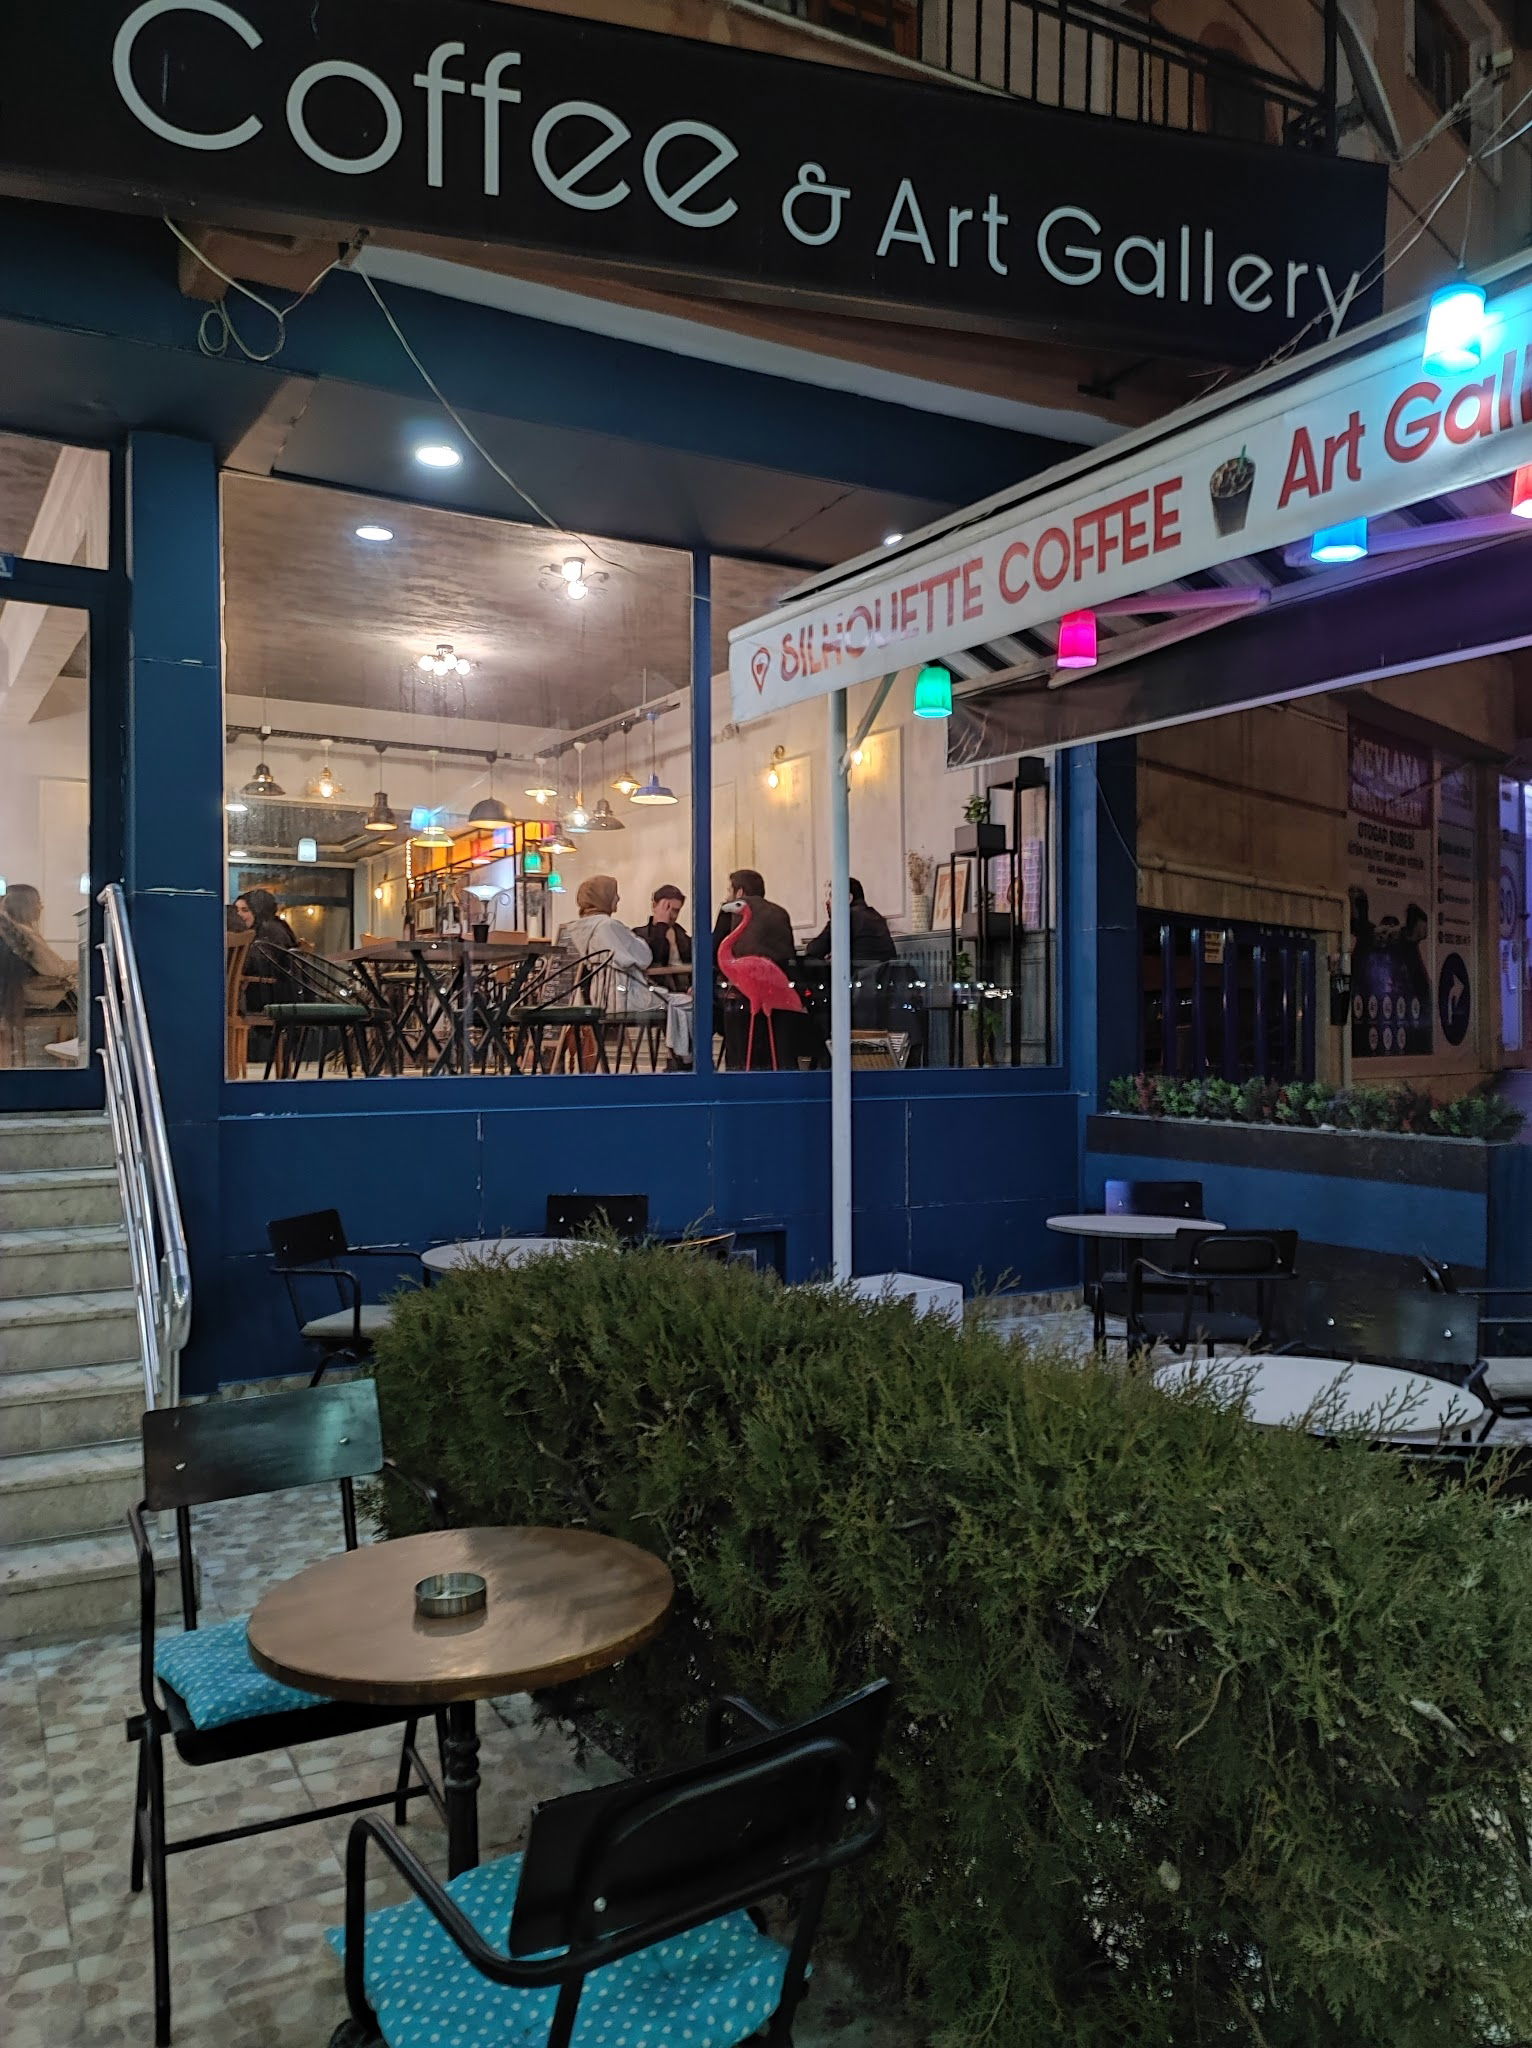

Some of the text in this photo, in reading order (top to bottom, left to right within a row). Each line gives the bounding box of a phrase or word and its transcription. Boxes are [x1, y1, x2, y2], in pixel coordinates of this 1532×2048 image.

[112, 0, 1361, 340] Coffee & Art Gallery
[779, 556, 984, 683] SILHOUETTE
[998, 475, 1183, 605] COFFEE
[1277, 410, 1366, 510] Art
